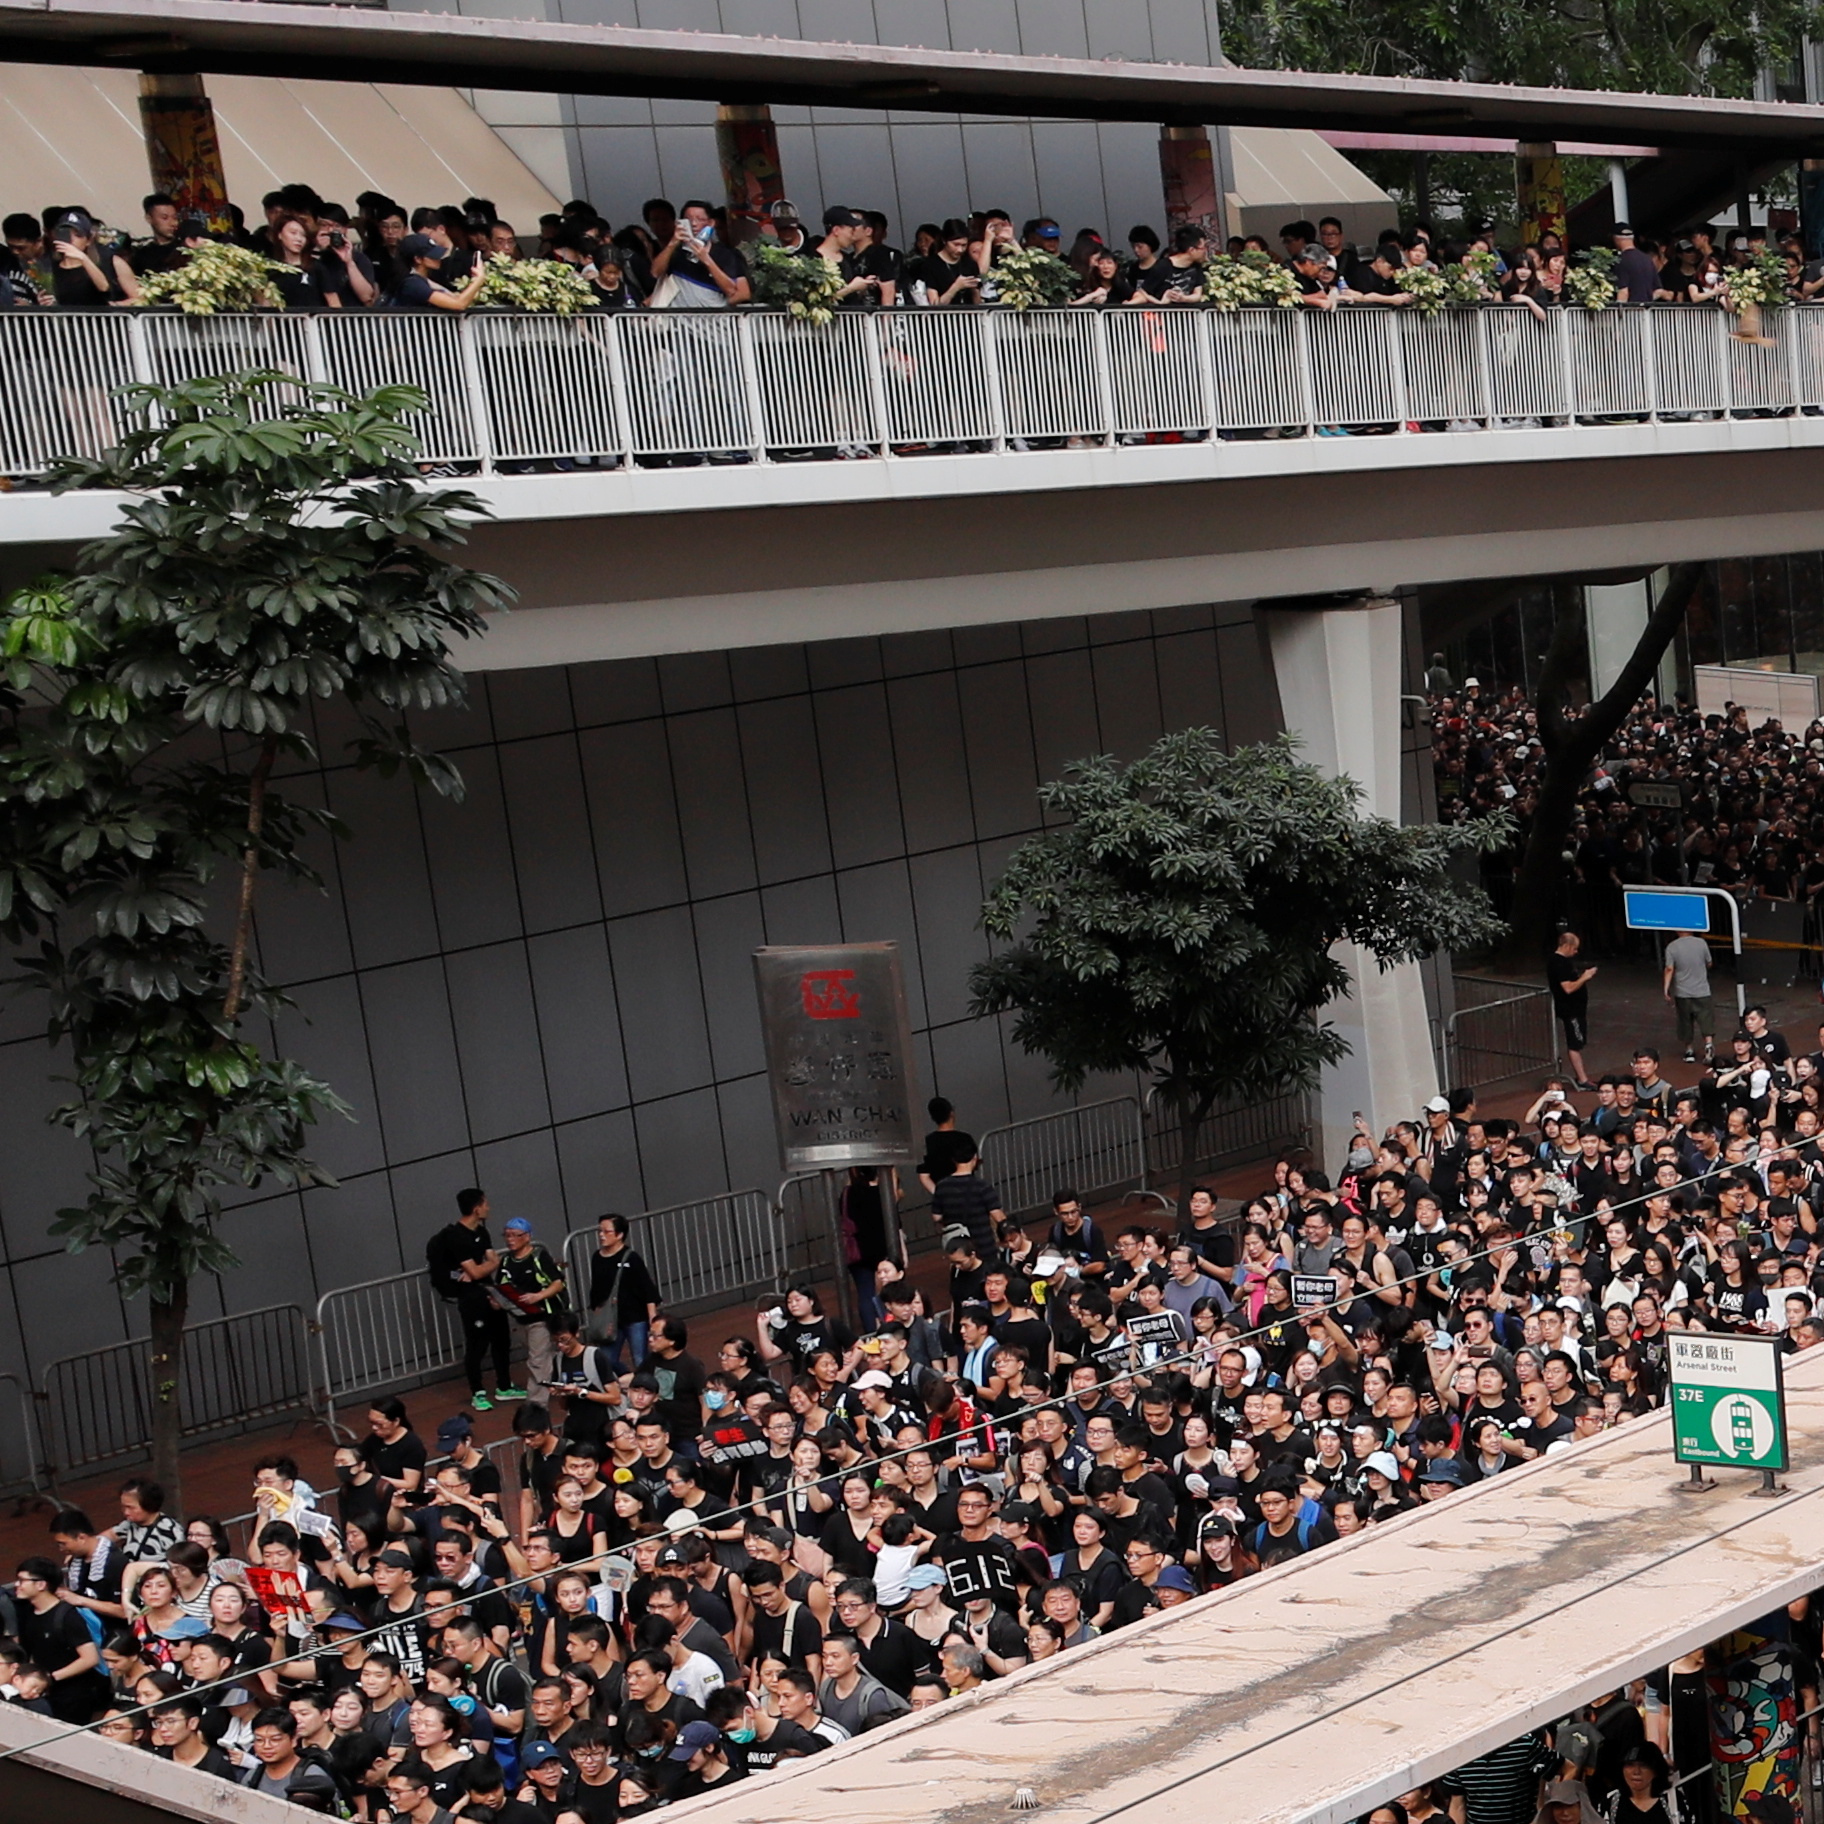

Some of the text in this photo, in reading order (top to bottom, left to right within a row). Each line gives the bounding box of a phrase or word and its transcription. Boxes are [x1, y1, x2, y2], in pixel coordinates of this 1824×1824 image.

[790, 1107, 846, 1127] WAN
[1675, 1343, 1734, 1362] 軍器廠街
[1676, 1360, 1738, 1374] Arsenal Street
[1679, 1388, 1704, 1404] 37E
[1678, 1446, 1720, 1458] Eastbound
[945, 1554, 1017, 1597] 6.12
